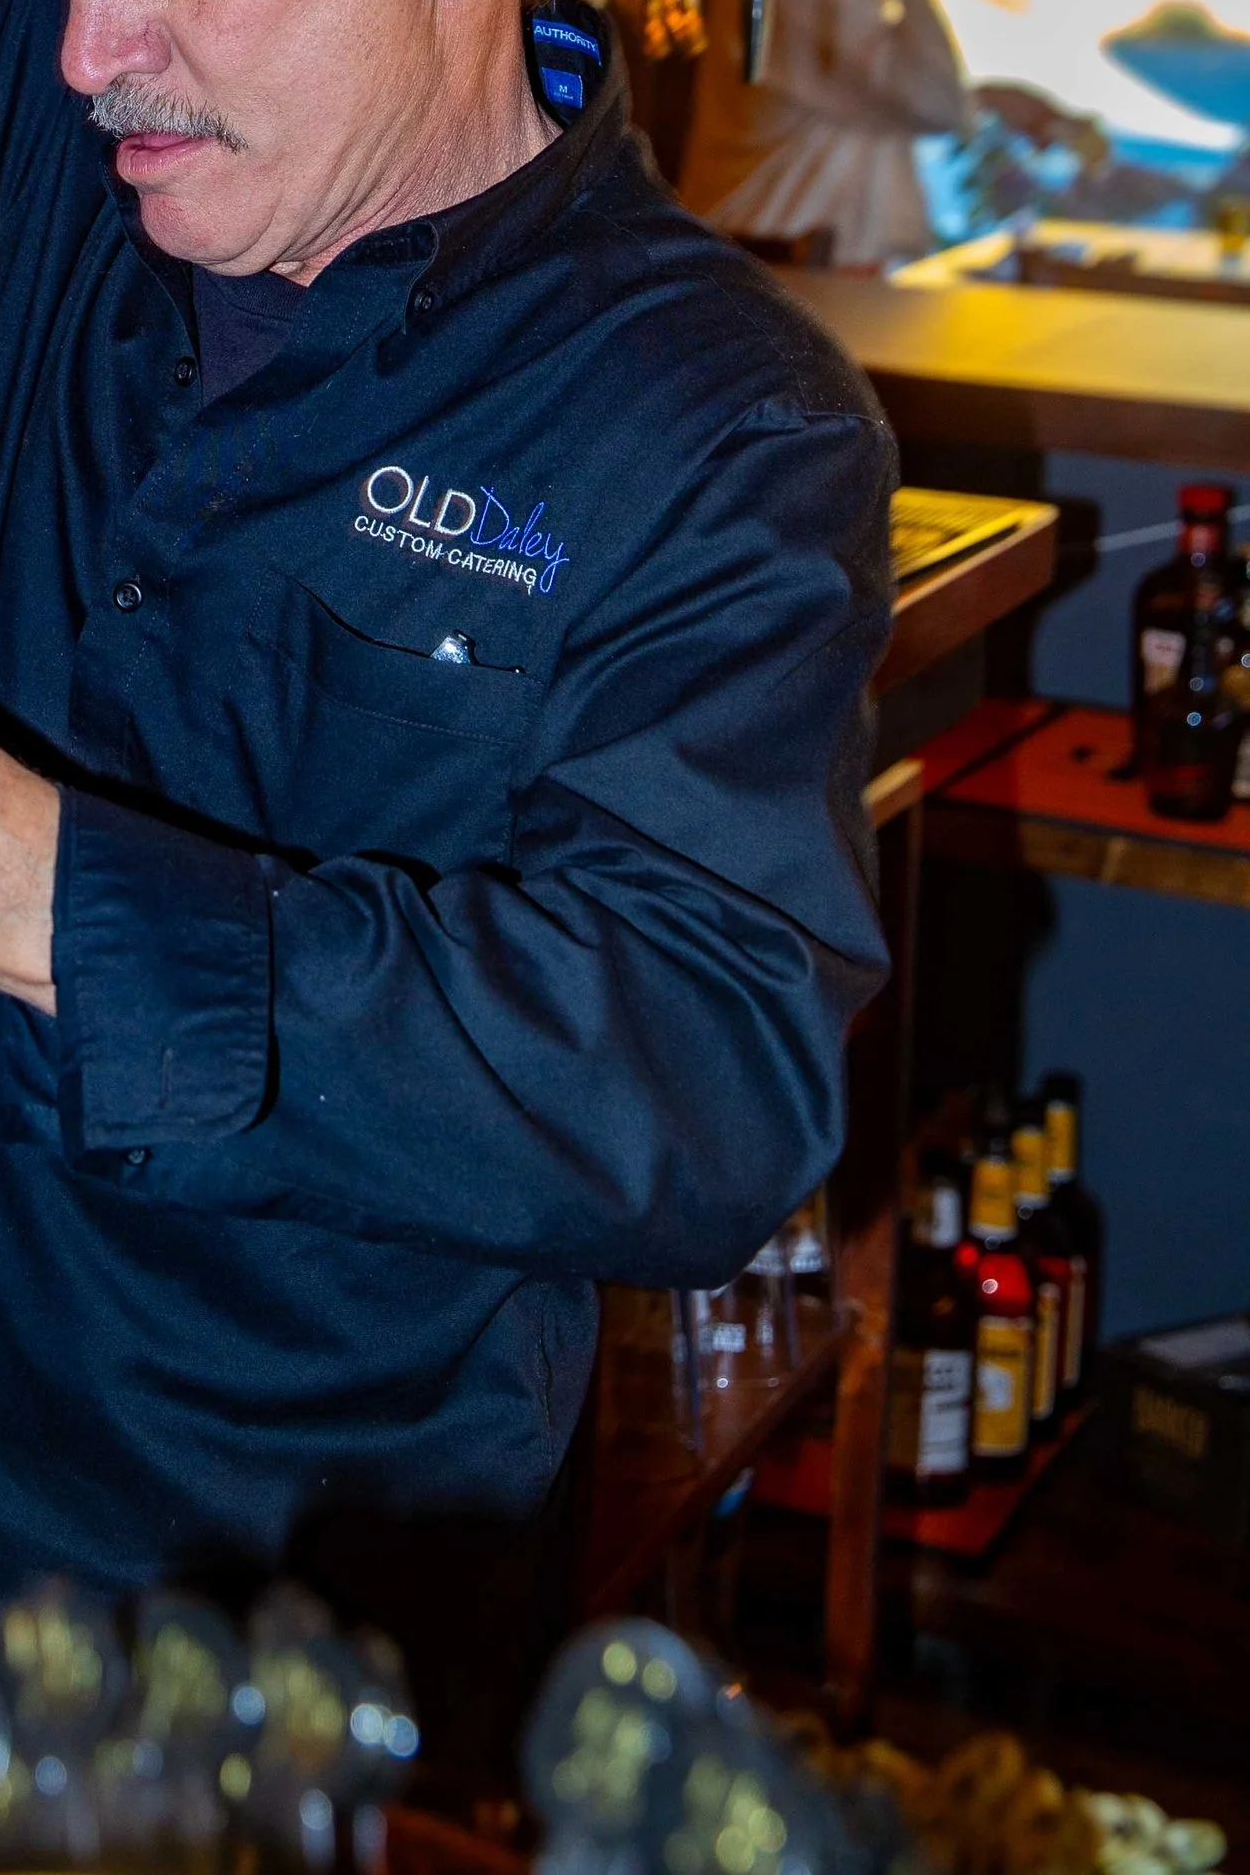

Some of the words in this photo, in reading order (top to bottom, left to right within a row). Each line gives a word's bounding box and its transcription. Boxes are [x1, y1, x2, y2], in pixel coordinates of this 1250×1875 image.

[534, 25, 598, 52] AUTHORITY
[354, 515, 444, 560] CUSTOM
[447, 549, 538, 587] CATERING
[366, 465, 476, 536] OLD
[470, 486, 569, 593] Daley
